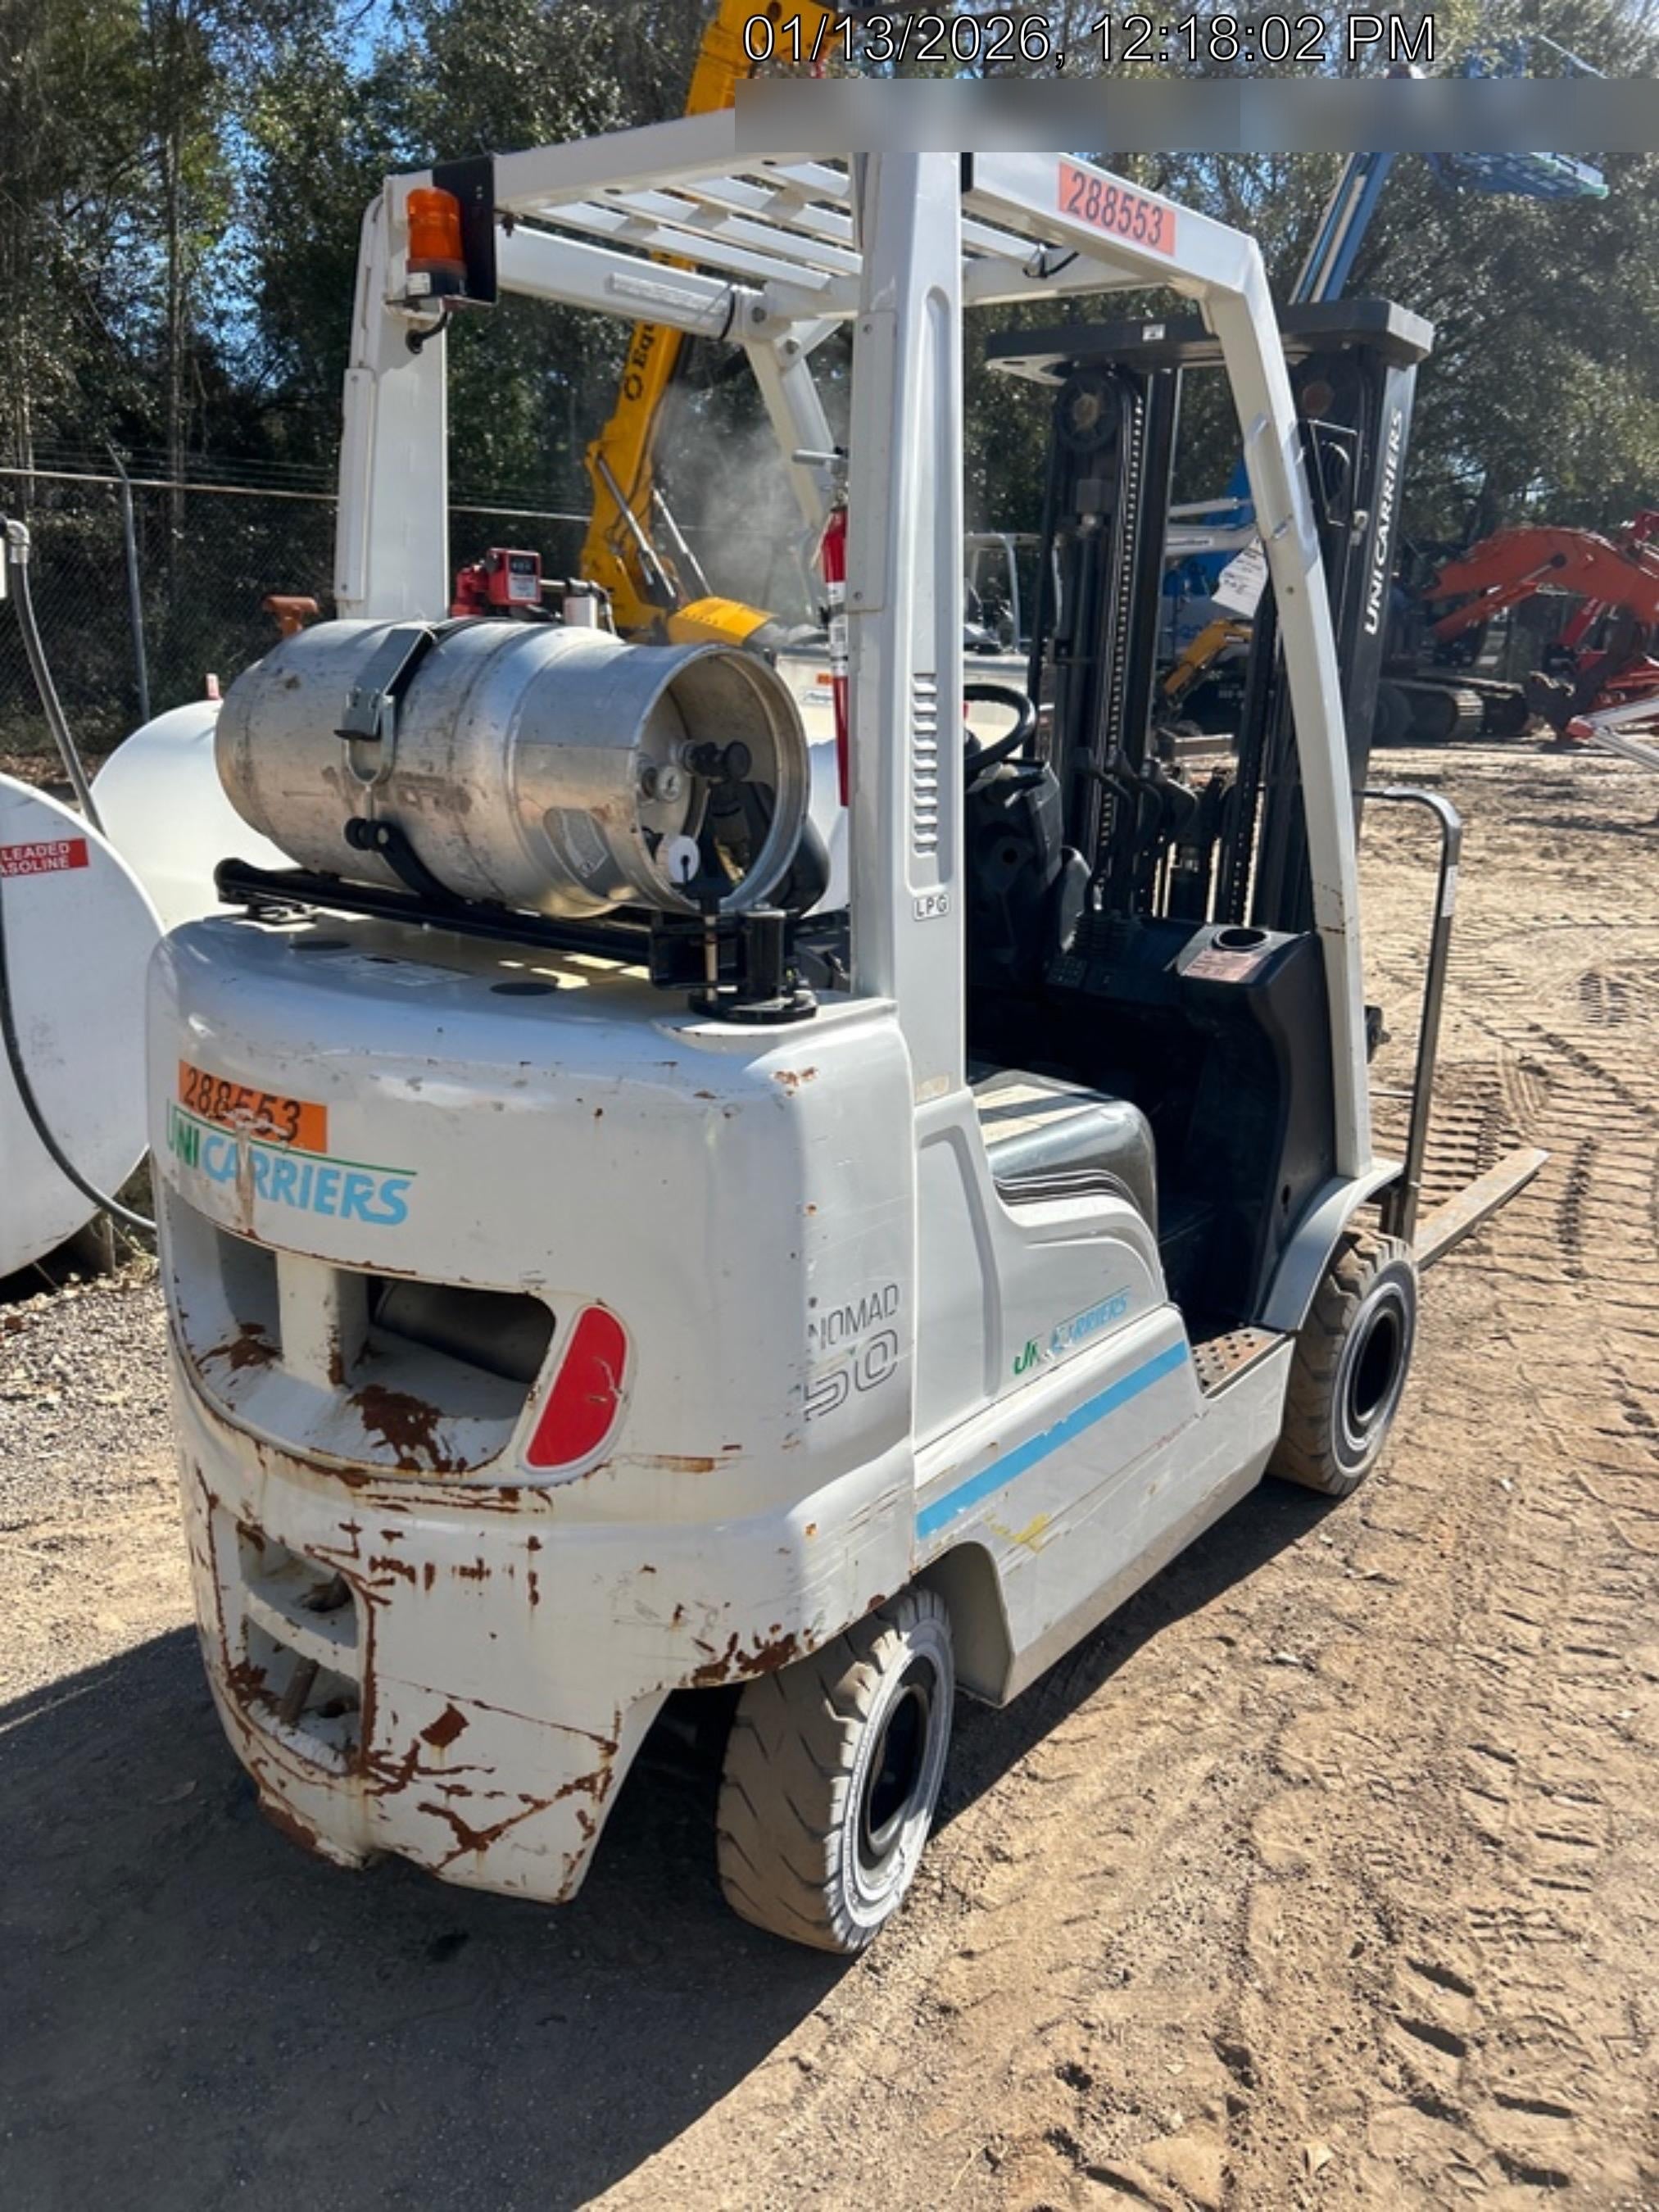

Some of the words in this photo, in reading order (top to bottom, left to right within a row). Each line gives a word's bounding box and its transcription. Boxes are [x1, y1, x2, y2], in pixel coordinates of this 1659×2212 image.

[1067, 171, 1163, 246] 288553
[1364, 407, 1402, 636] UNICARRIERS
[917, 895, 948, 917] LPG
